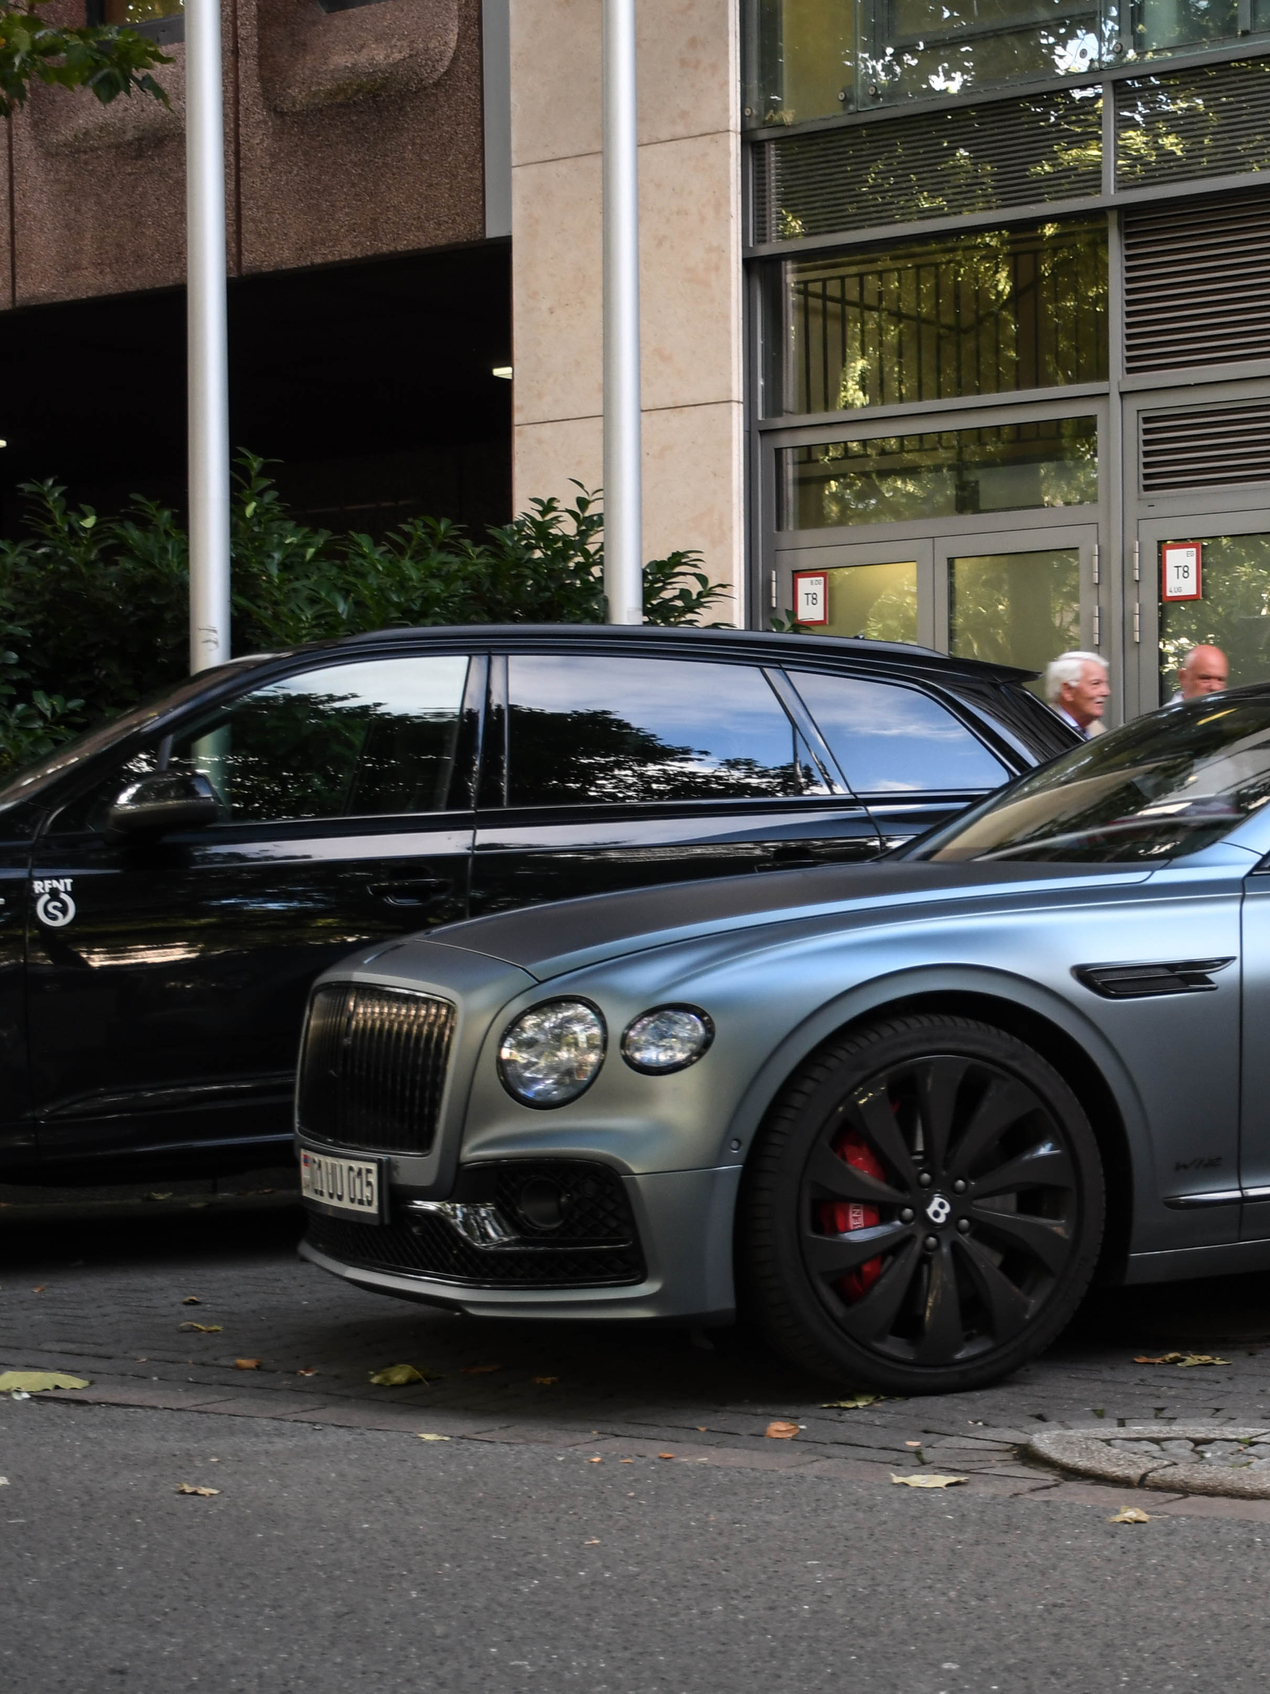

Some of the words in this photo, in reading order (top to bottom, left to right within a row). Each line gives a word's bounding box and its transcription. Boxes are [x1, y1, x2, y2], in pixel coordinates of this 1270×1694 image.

[1173, 565, 1190, 580] T8
[804, 592, 818, 606] T8
[33, 878, 74, 894] RENT
[347, 1165, 374, 1207] 015
